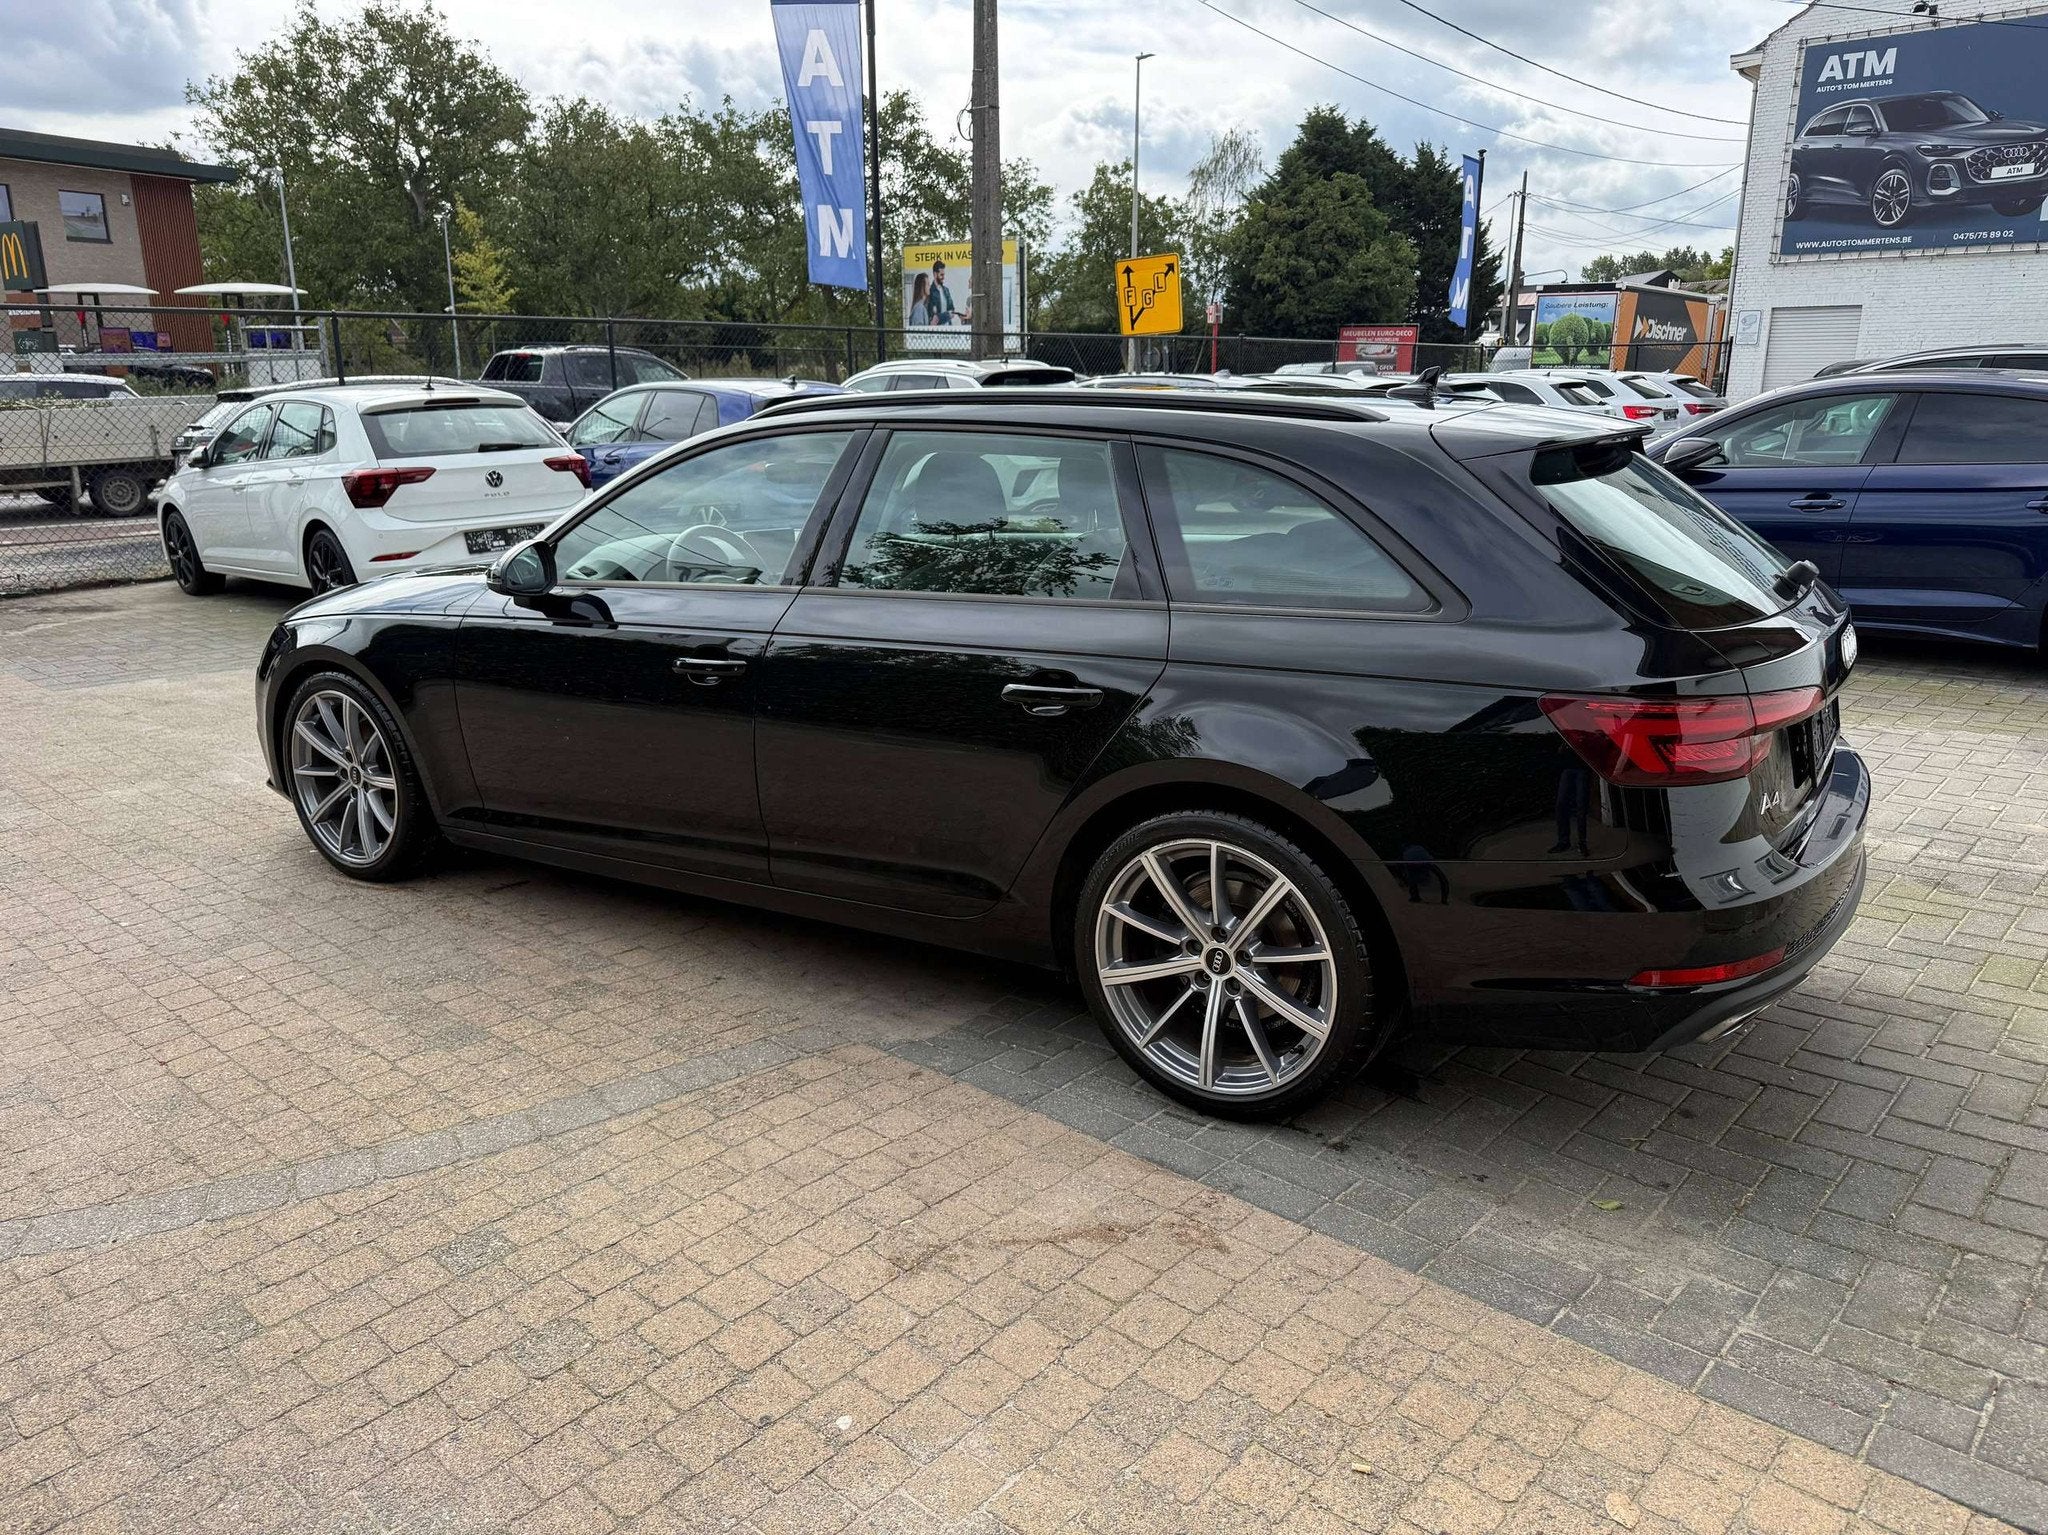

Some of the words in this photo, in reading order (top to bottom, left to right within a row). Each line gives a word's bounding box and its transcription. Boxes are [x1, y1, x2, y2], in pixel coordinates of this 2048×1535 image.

[1817, 48, 1897, 82] ATM
[1816, 84, 1842, 93] AUTO'S
[1843, 82, 1859, 90] TOM
[1860, 79, 1893, 88] MERTENS
[1953, 231, 1988, 240] 0475/75
[1989, 230, 2001, 239] 89
[2002, 229, 2014, 238] 02
[1451, 175, 1474, 310] ATM
[1796, 236, 1912, 249] WWW.AUTOSTOMMERTENS.BE
[915, 251, 941, 262] STERK
[944, 251, 953, 260] IN
[1156, 276, 1163, 289] L
[1127, 290, 1133, 303] F
[1144, 292, 1152, 305] G
[1377, 329, 1413, 337] EURO-DECO
[1645, 318, 1688, 341] Dischner
[1760, 791, 1780, 815] A4
